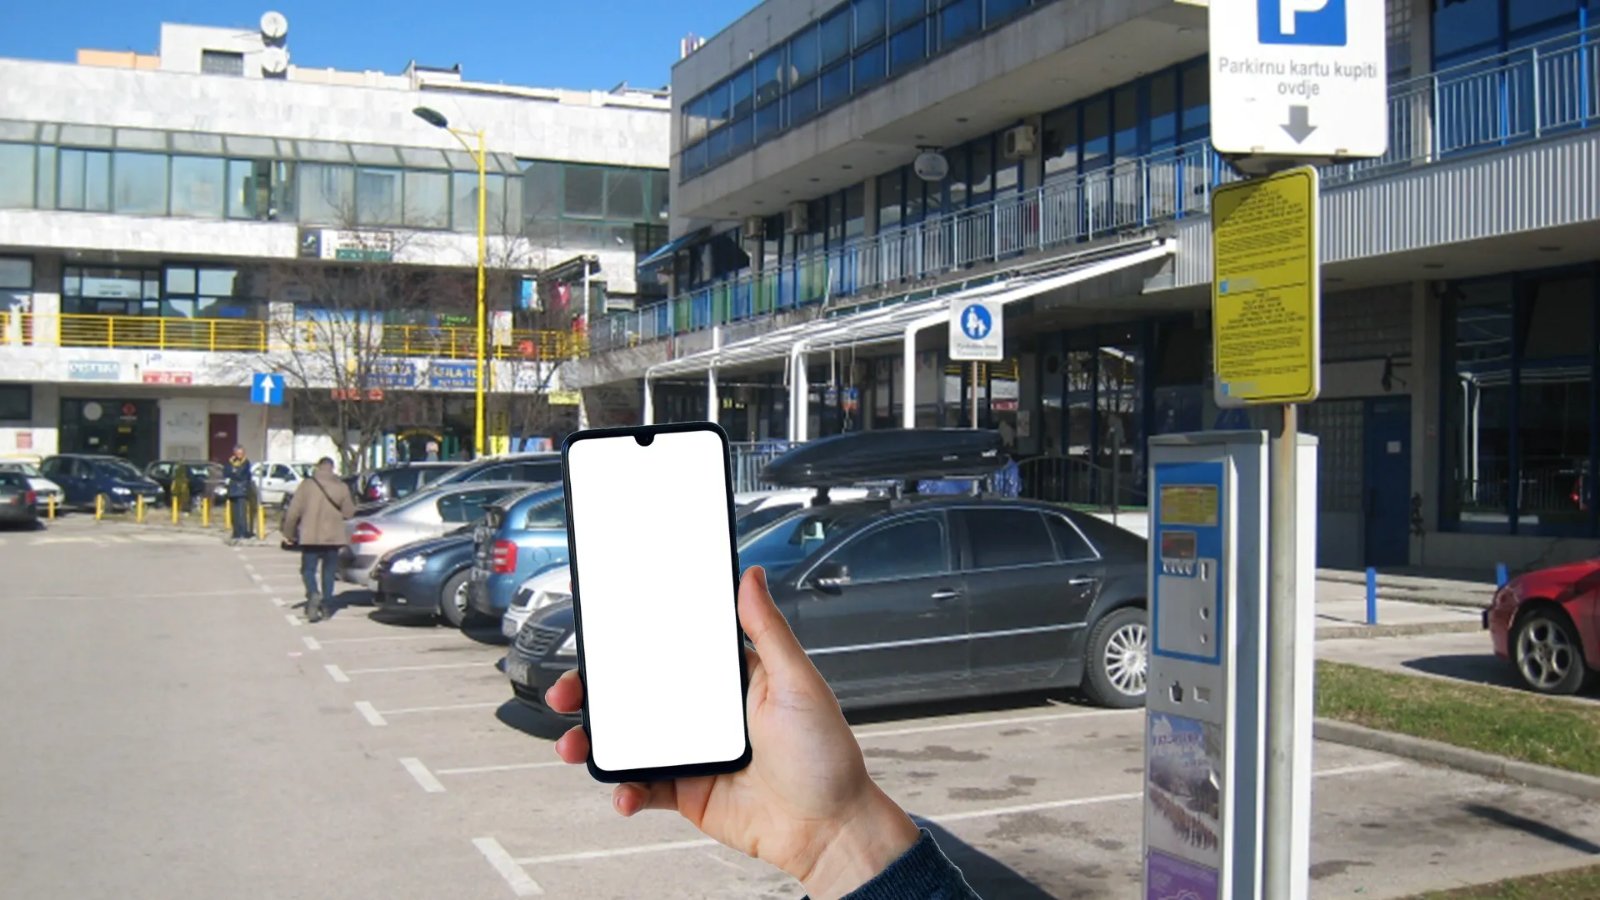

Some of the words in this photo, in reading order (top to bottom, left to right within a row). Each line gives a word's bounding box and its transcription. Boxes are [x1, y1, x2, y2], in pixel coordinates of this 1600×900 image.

[1218, 57, 1286, 76] Parkirnu
[1290, 59, 1330, 77] kartu
[1334, 61, 1377, 81] kupiti
[1278, 80, 1320, 99] ovdje
